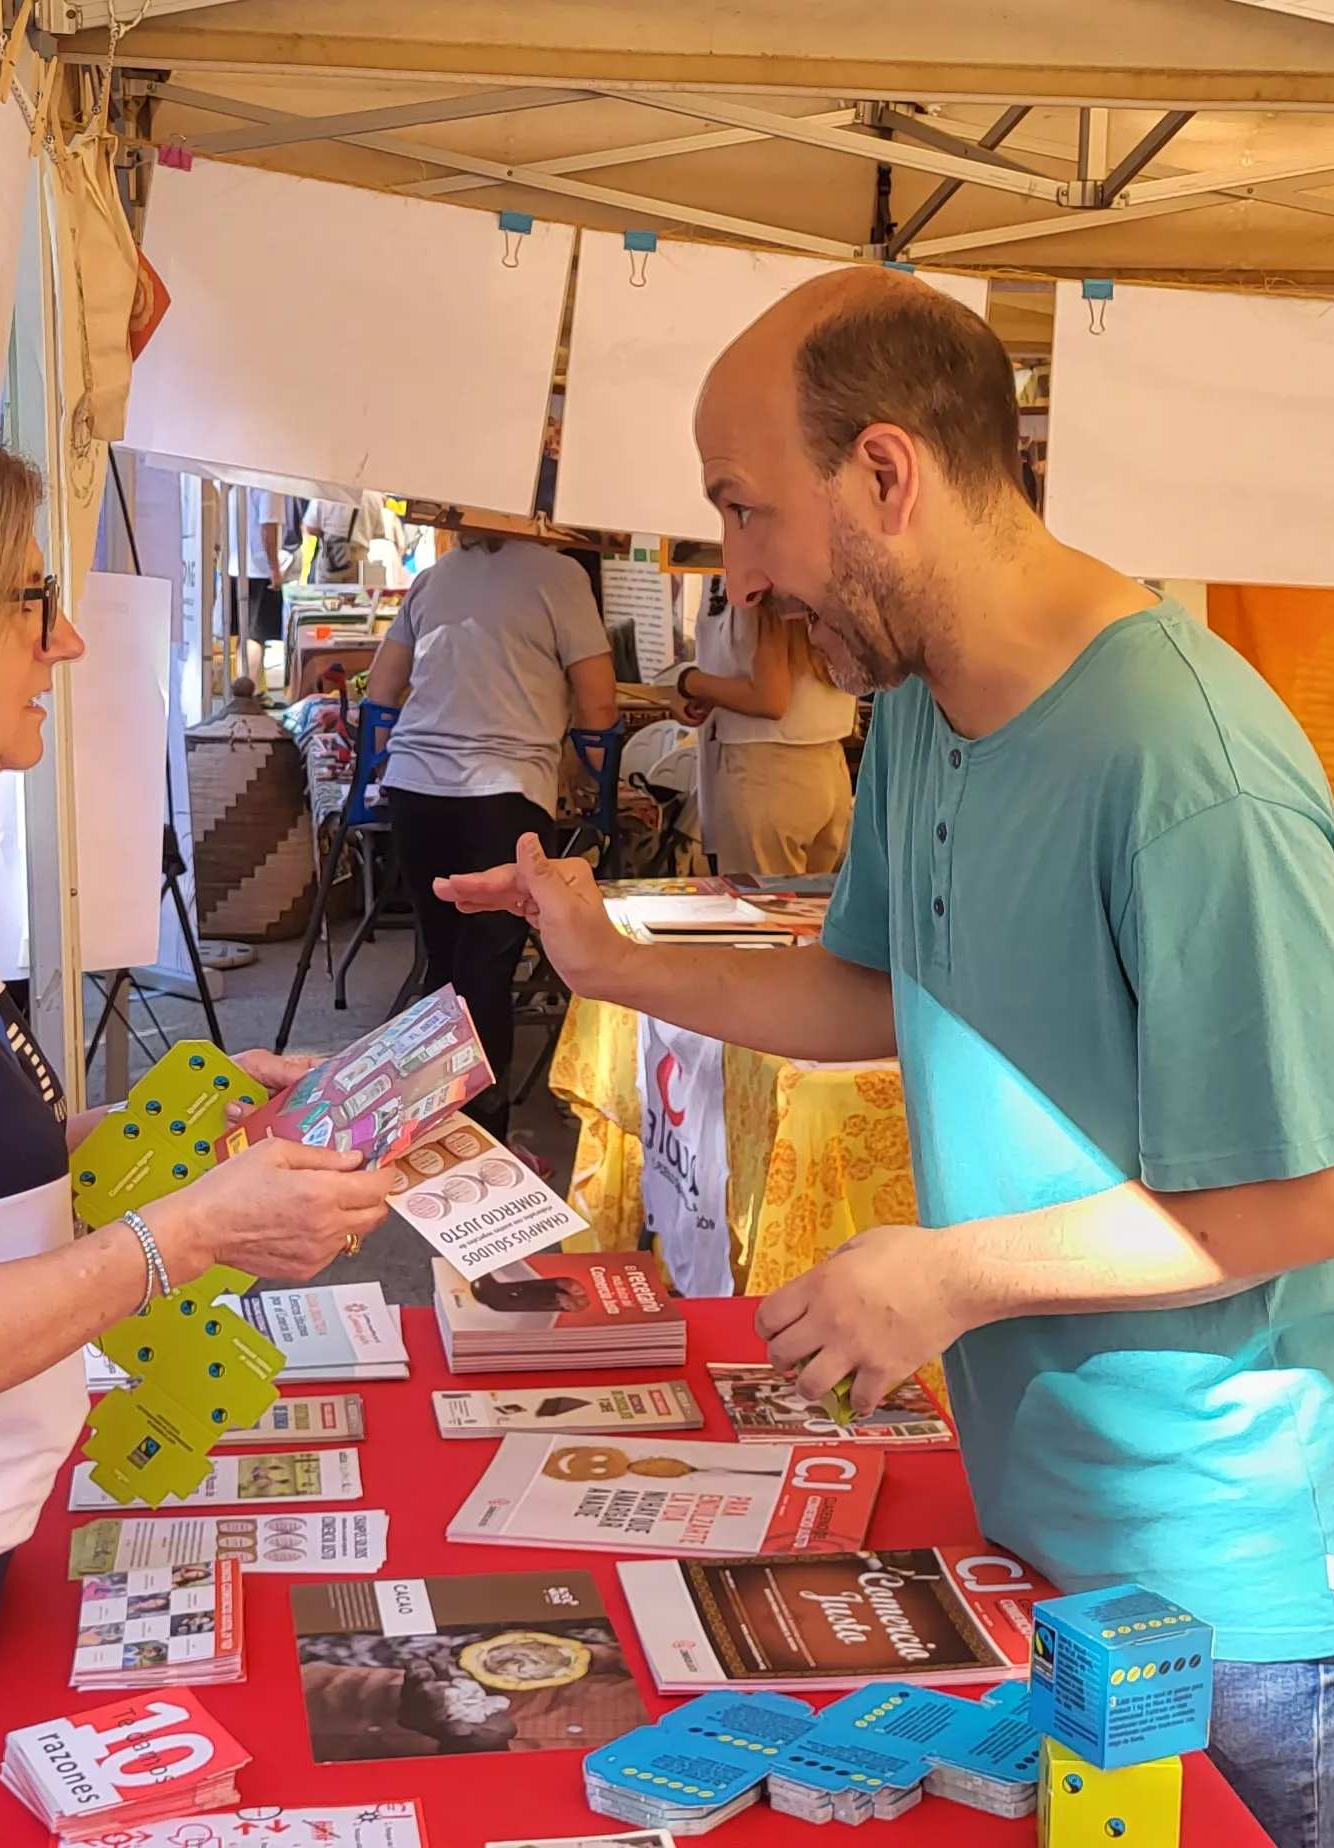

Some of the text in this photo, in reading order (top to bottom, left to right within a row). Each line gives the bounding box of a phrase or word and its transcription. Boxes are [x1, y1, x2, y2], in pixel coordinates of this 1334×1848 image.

[440, 1190, 548, 1244] COMERCIO JUSTO
[461, 1212, 570, 1266] CHAMPÚS SÓLIDOS
[589, 1266, 615, 1299] Comercio
[626, 1271, 665, 1312] recetario
[793, 1456, 857, 1492] CJ
[597, 1489, 640, 1529] AMARGAR
[624, 1517, 657, 1535] QUE
[721, 1495, 753, 1517] PARA
[955, 1556, 1033, 1593] CJ
[393, 1583, 414, 1615] CACAO
[798, 1589, 872, 1646] Justo
[857, 1571, 937, 1662] Comercio
[96, 1701, 215, 1788] 10
[111, 1706, 176, 1785] Te damos
[37, 1731, 101, 1804] razones
